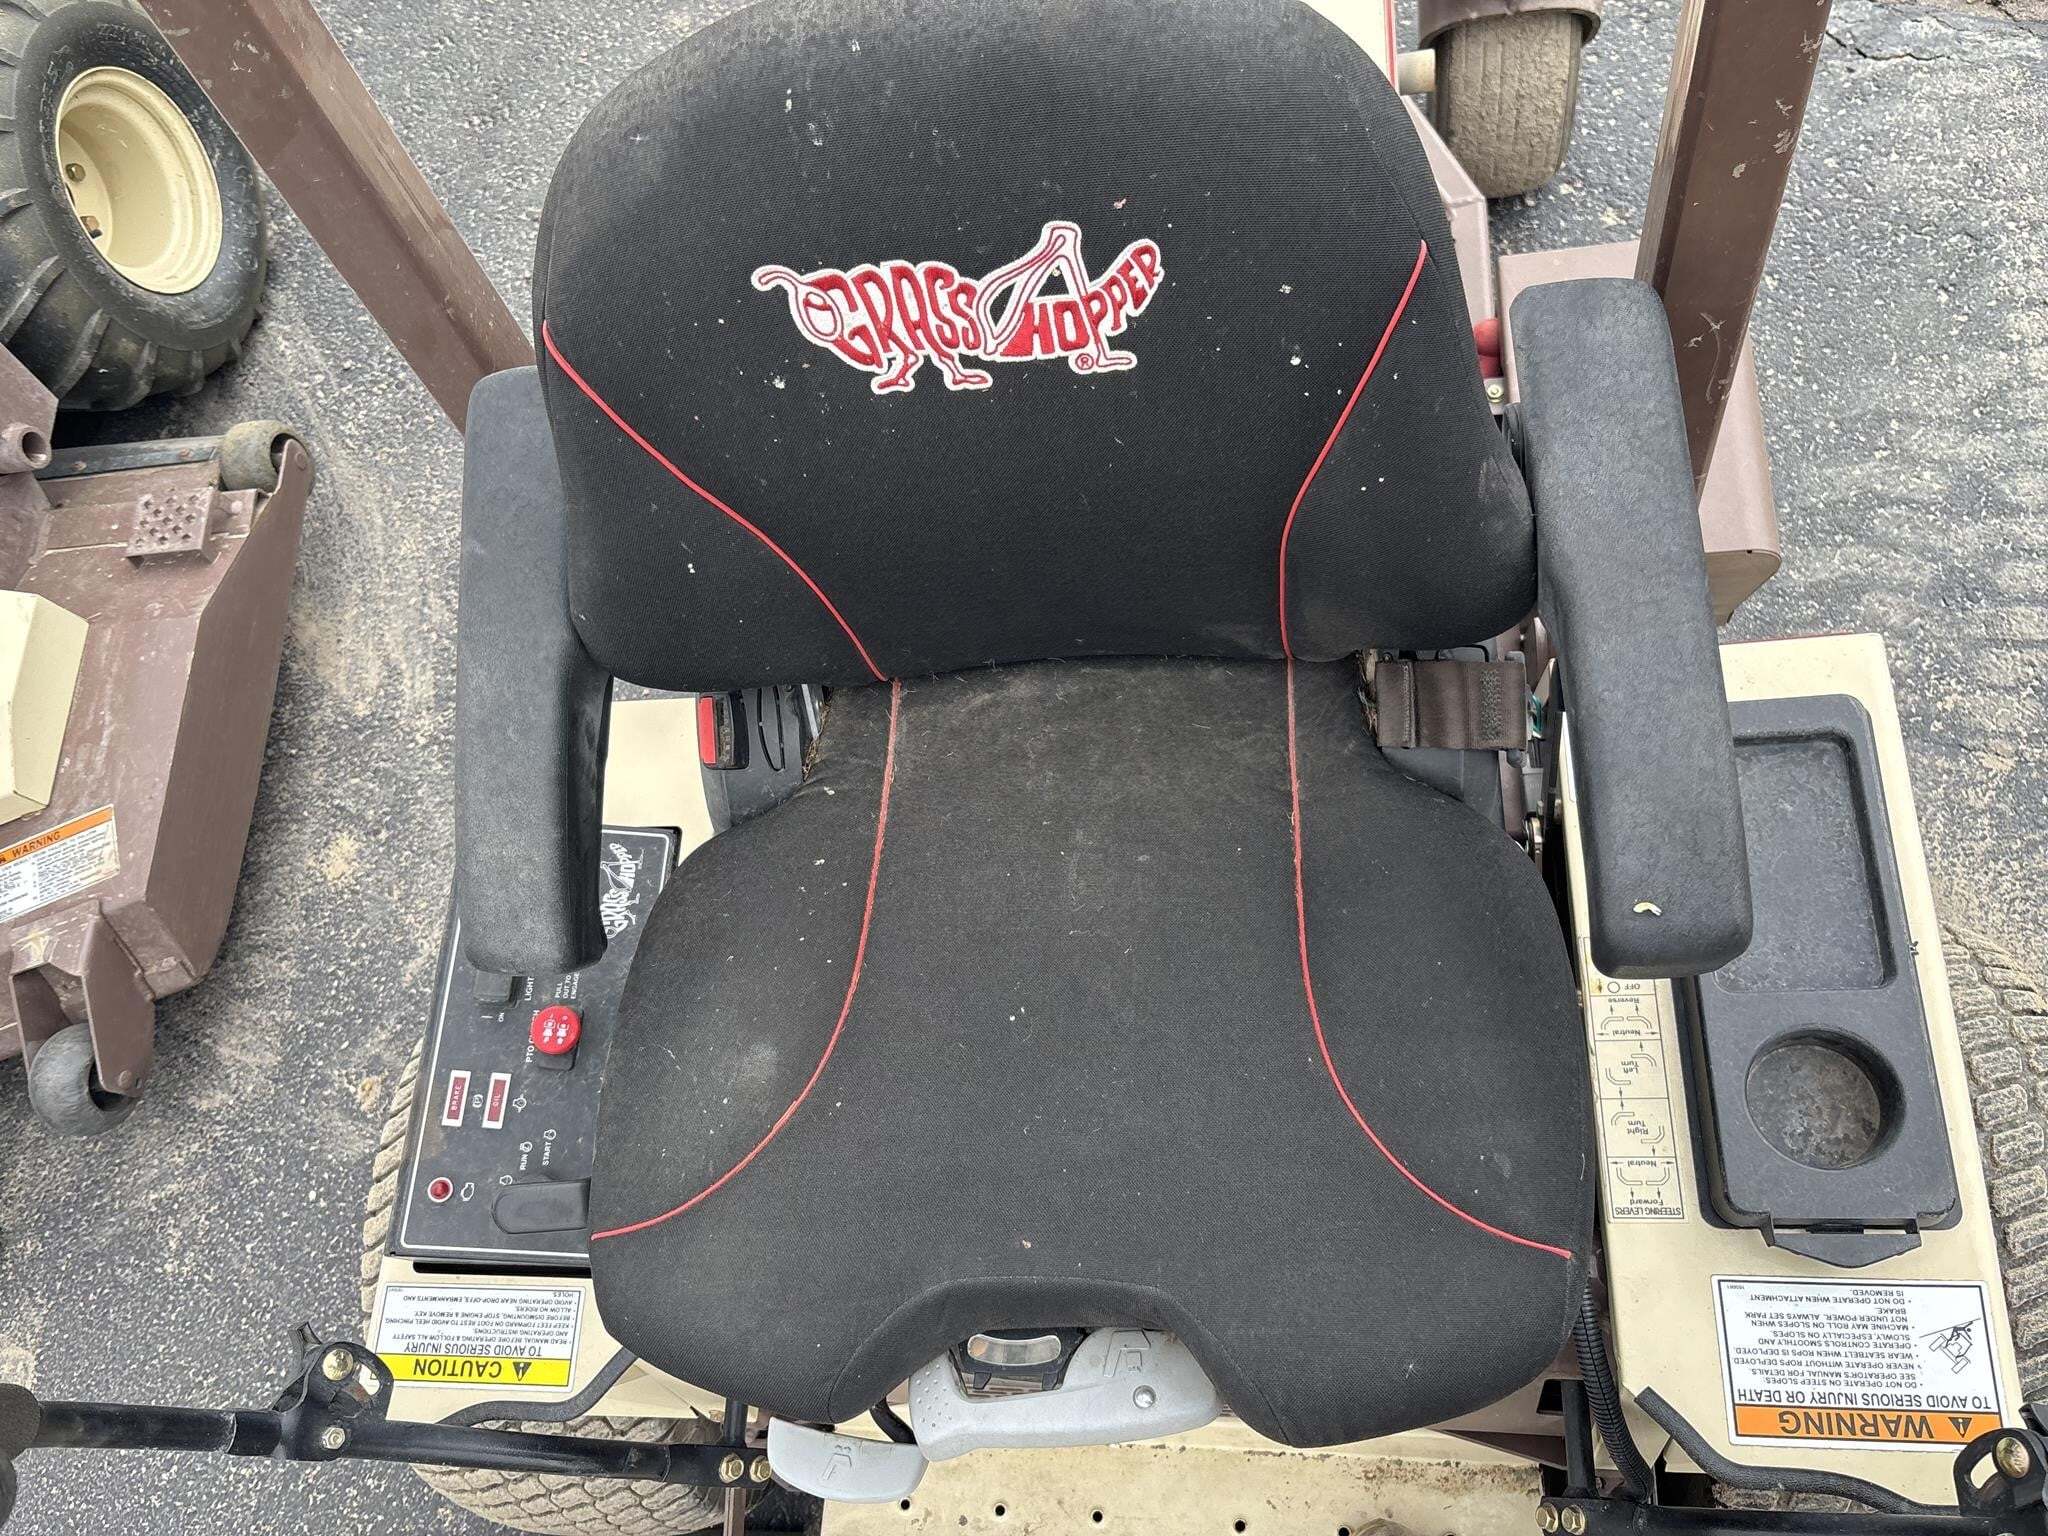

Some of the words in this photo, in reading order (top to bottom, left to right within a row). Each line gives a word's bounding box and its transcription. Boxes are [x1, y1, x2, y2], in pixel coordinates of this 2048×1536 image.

[11, 831, 61, 858] WARNING
[565, 974, 572, 984] TO
[555, 982, 563, 998] PULL
[571, 972, 580, 999] ENGAGE
[498, 1012, 505, 1022] ON
[1612, 1029, 1641, 1037] Neutral
[526, 1044, 535, 1063] PTO
[450, 1083, 462, 1111] BRAKE
[492, 1093, 501, 1107] OIL
[1627, 1127, 1649, 1135] Right
[542, 1142, 552, 1166] START
[520, 1154, 528, 1171] RUN
[1630, 1198, 1664, 1206] Forward
[1614, 1206, 1643, 1215] LEVERS
[1645, 1206, 1682, 1216] STEERING
[1748, 1294, 1803, 1302] ATTACHMENT
[1805, 1295, 1830, 1303] WHEN
[1831, 1296, 1871, 1304] OPERATE
[1785, 1312, 1819, 1320] ALWAYS
[1823, 1313, 1857, 1321] POWER.
[1776, 1320, 1810, 1328] SLOPES
[1826, 1321, 1848, 1329] ROLL
[1821, 1331, 1872, 1339] ESPECIALLY
[403, 1342, 442, 1353] INJURY
[443, 1343, 491, 1354] SERIOUS
[493, 1344, 526, 1356] AVOID
[527, 1345, 542, 1356] TO
[1842, 1350, 1885, 1358] SEATBELT
[412, 1358, 502, 1378] CAUTION
[1786, 1369, 1804, 1377] FOR
[1806, 1370, 1841, 1378] MANUAL
[1843, 1371, 1897, 1379] OPERATOR'S
[1898, 1372, 1915, 1380] SEE
[1843, 1379, 1882, 1387] OPERATE
[1737, 1388, 1781, 1402] DEATH
[1784, 1390, 1805, 1403] OR
[1808, 1391, 1858, 1405] INJURY
[1861, 1392, 1922, 1407] SERIOUS
[1925, 1394, 1968, 1408] AVOID
[1971, 1395, 1991, 1409] TO
[1777, 1410, 1934, 1438] WARNING
